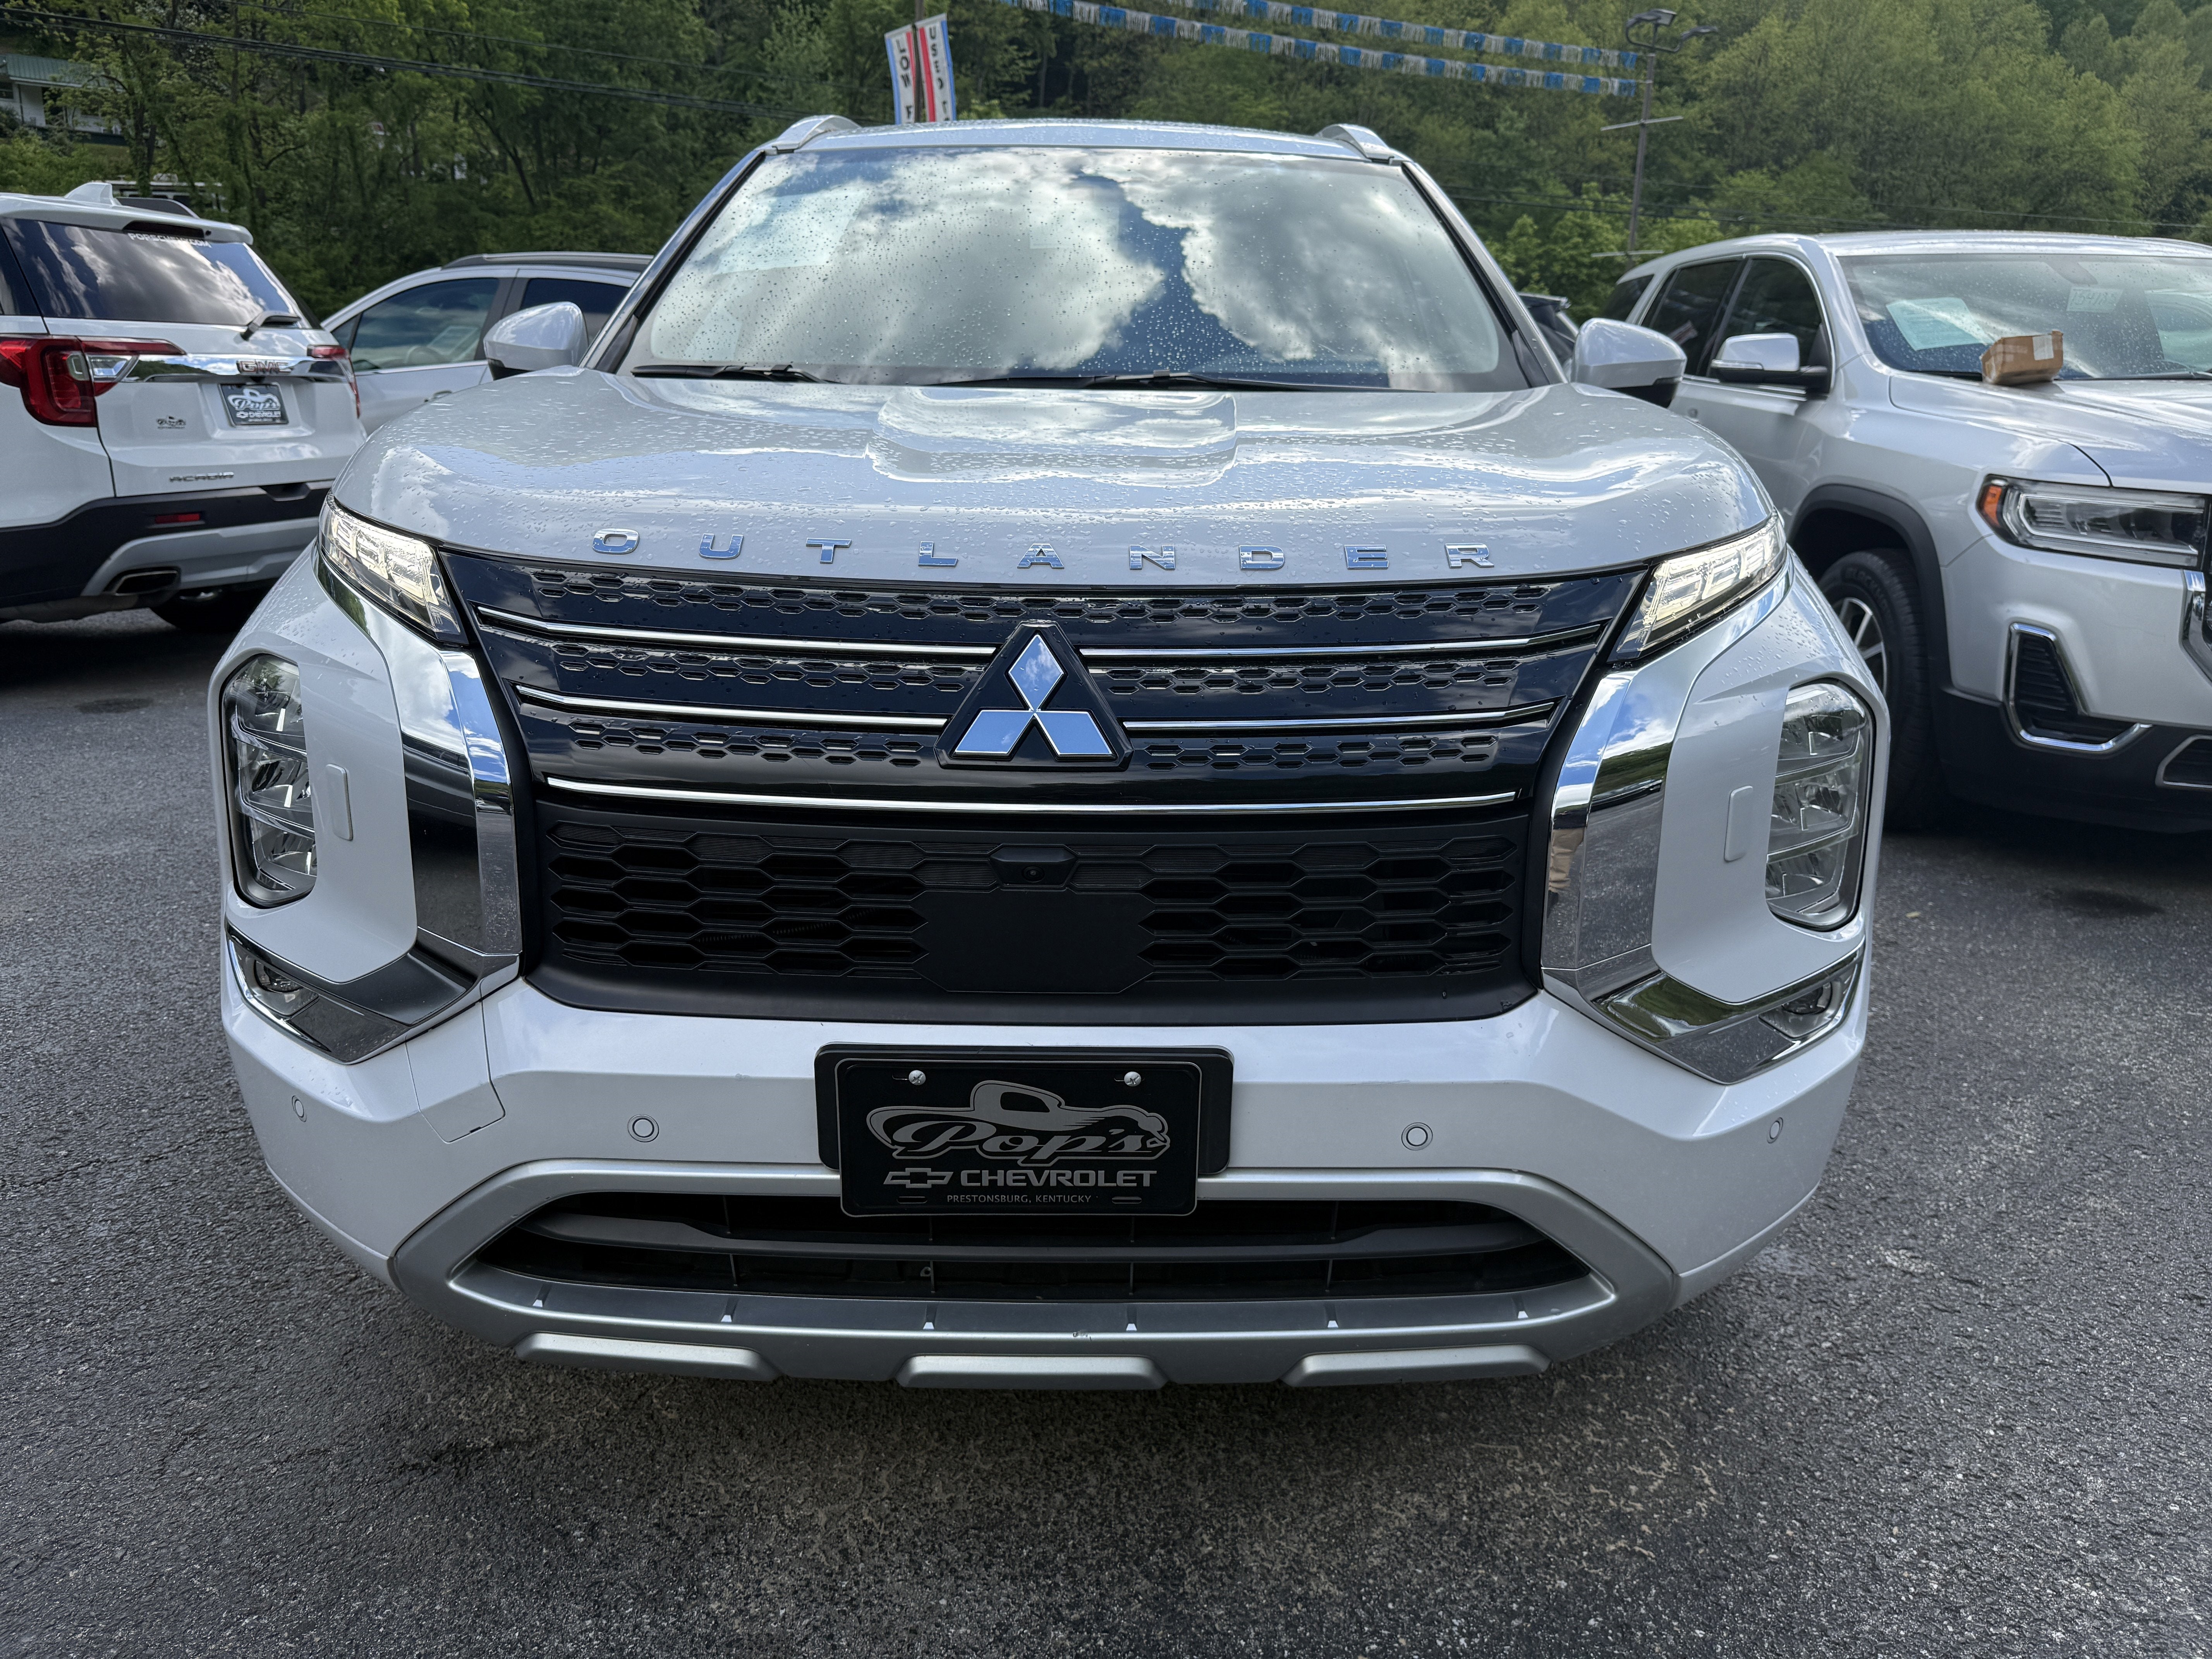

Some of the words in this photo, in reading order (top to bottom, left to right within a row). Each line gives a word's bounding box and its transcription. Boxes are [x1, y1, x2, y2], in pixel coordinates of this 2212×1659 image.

[237, 360, 292, 373] GMC
[169, 471, 234, 483] ACADIA
[592, 528, 1495, 571] OUTLANDER
[892, 1121, 1153, 1159] Pop's
[960, 1170, 1157, 1187] CHEVROLET
[947, 1194, 1031, 1203] PRESTONSBURG,
[1035, 1194, 1092, 1203] KENTUCKY
